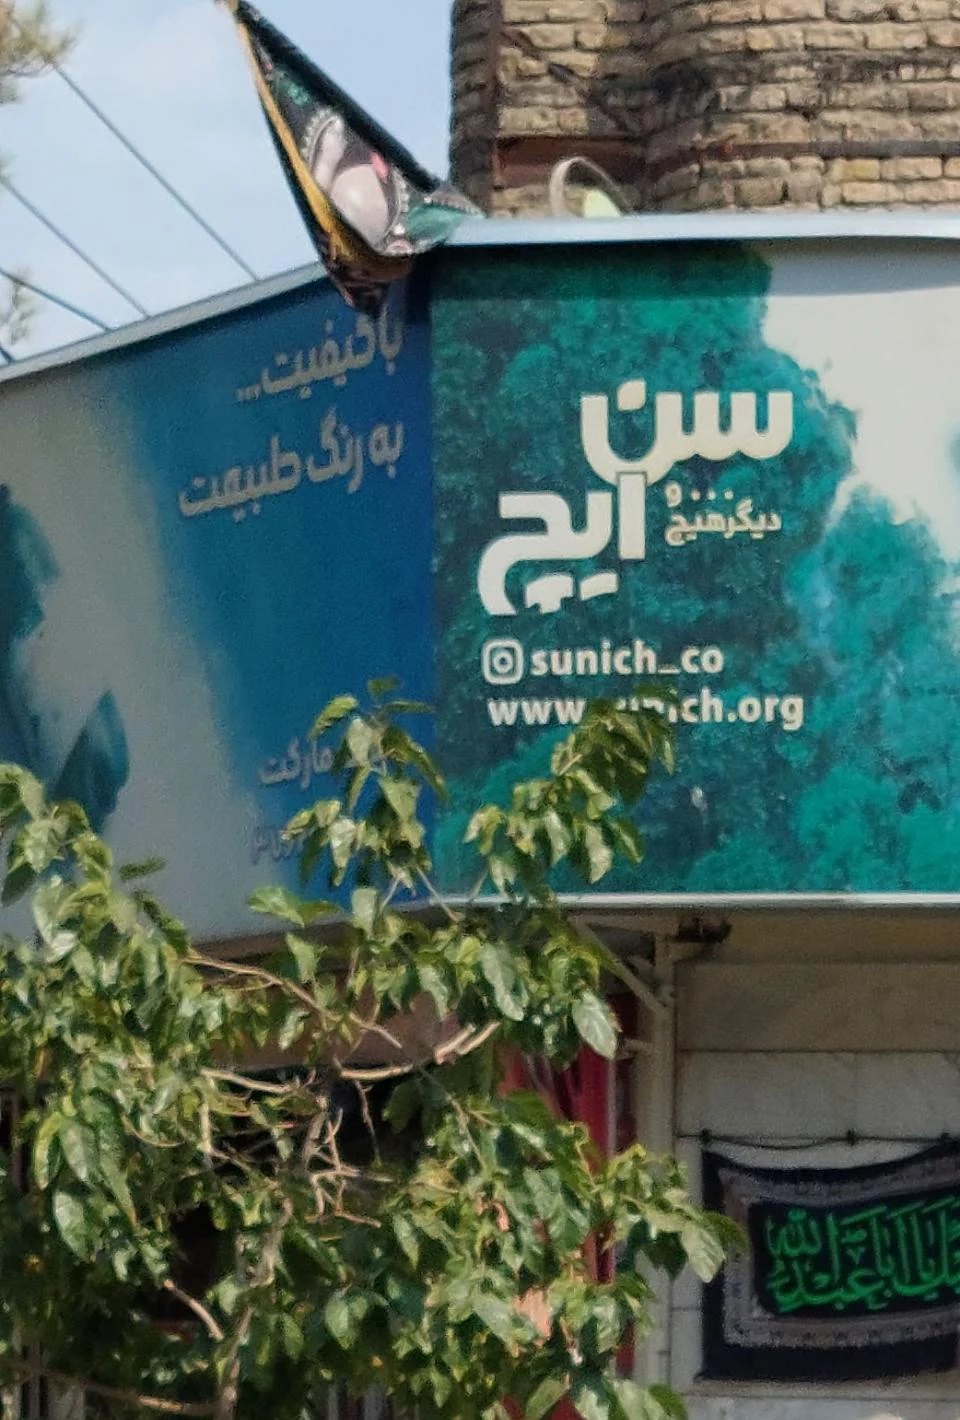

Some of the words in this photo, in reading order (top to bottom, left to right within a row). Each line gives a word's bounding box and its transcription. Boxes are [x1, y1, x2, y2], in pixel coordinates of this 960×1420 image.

[306, 404, 364, 495] رنگ
[368, 421, 404, 480] به
[580, 378, 793, 488] سن
[178, 432, 302, 524] طبیعت
[529, 638, 726, 677] sunich_co
[486, 687, 805, 732] wwwich.org
